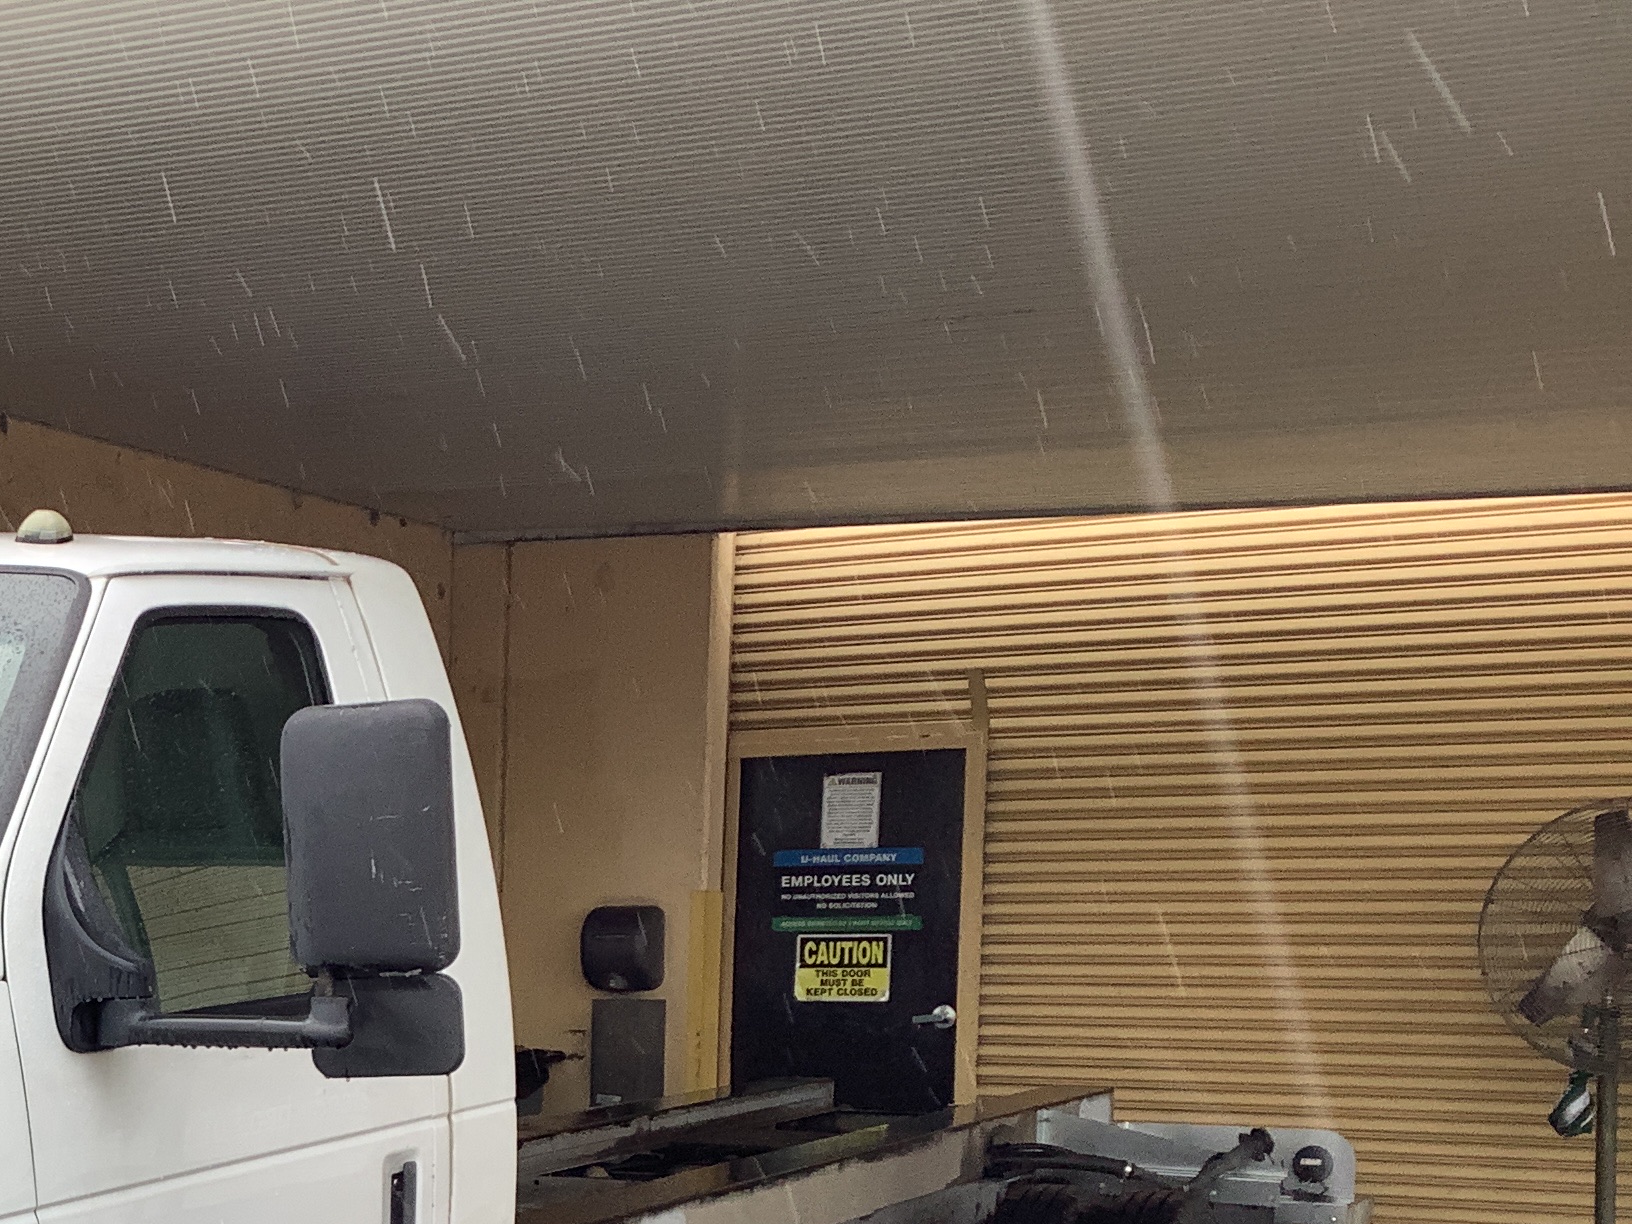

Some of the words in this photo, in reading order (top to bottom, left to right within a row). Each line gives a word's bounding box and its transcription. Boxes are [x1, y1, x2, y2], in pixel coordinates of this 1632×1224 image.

[801, 854, 840, 863] U-HAUL
[843, 853, 897, 862] COMPANY
[781, 874, 871, 887] EMPLOYEES
[876, 873, 915, 885] ONLY
[793, 892, 847, 900] UNAUTHORIZED
[804, 941, 884, 964] CAUTION
[815, 969, 838, 977] THIS
[842, 969, 871, 977] DOOR
[820, 978, 848, 986] MUST
[851, 978, 864, 986] BE
[806, 988, 833, 996] KEPT
[837, 988, 878, 996] CLOSED
